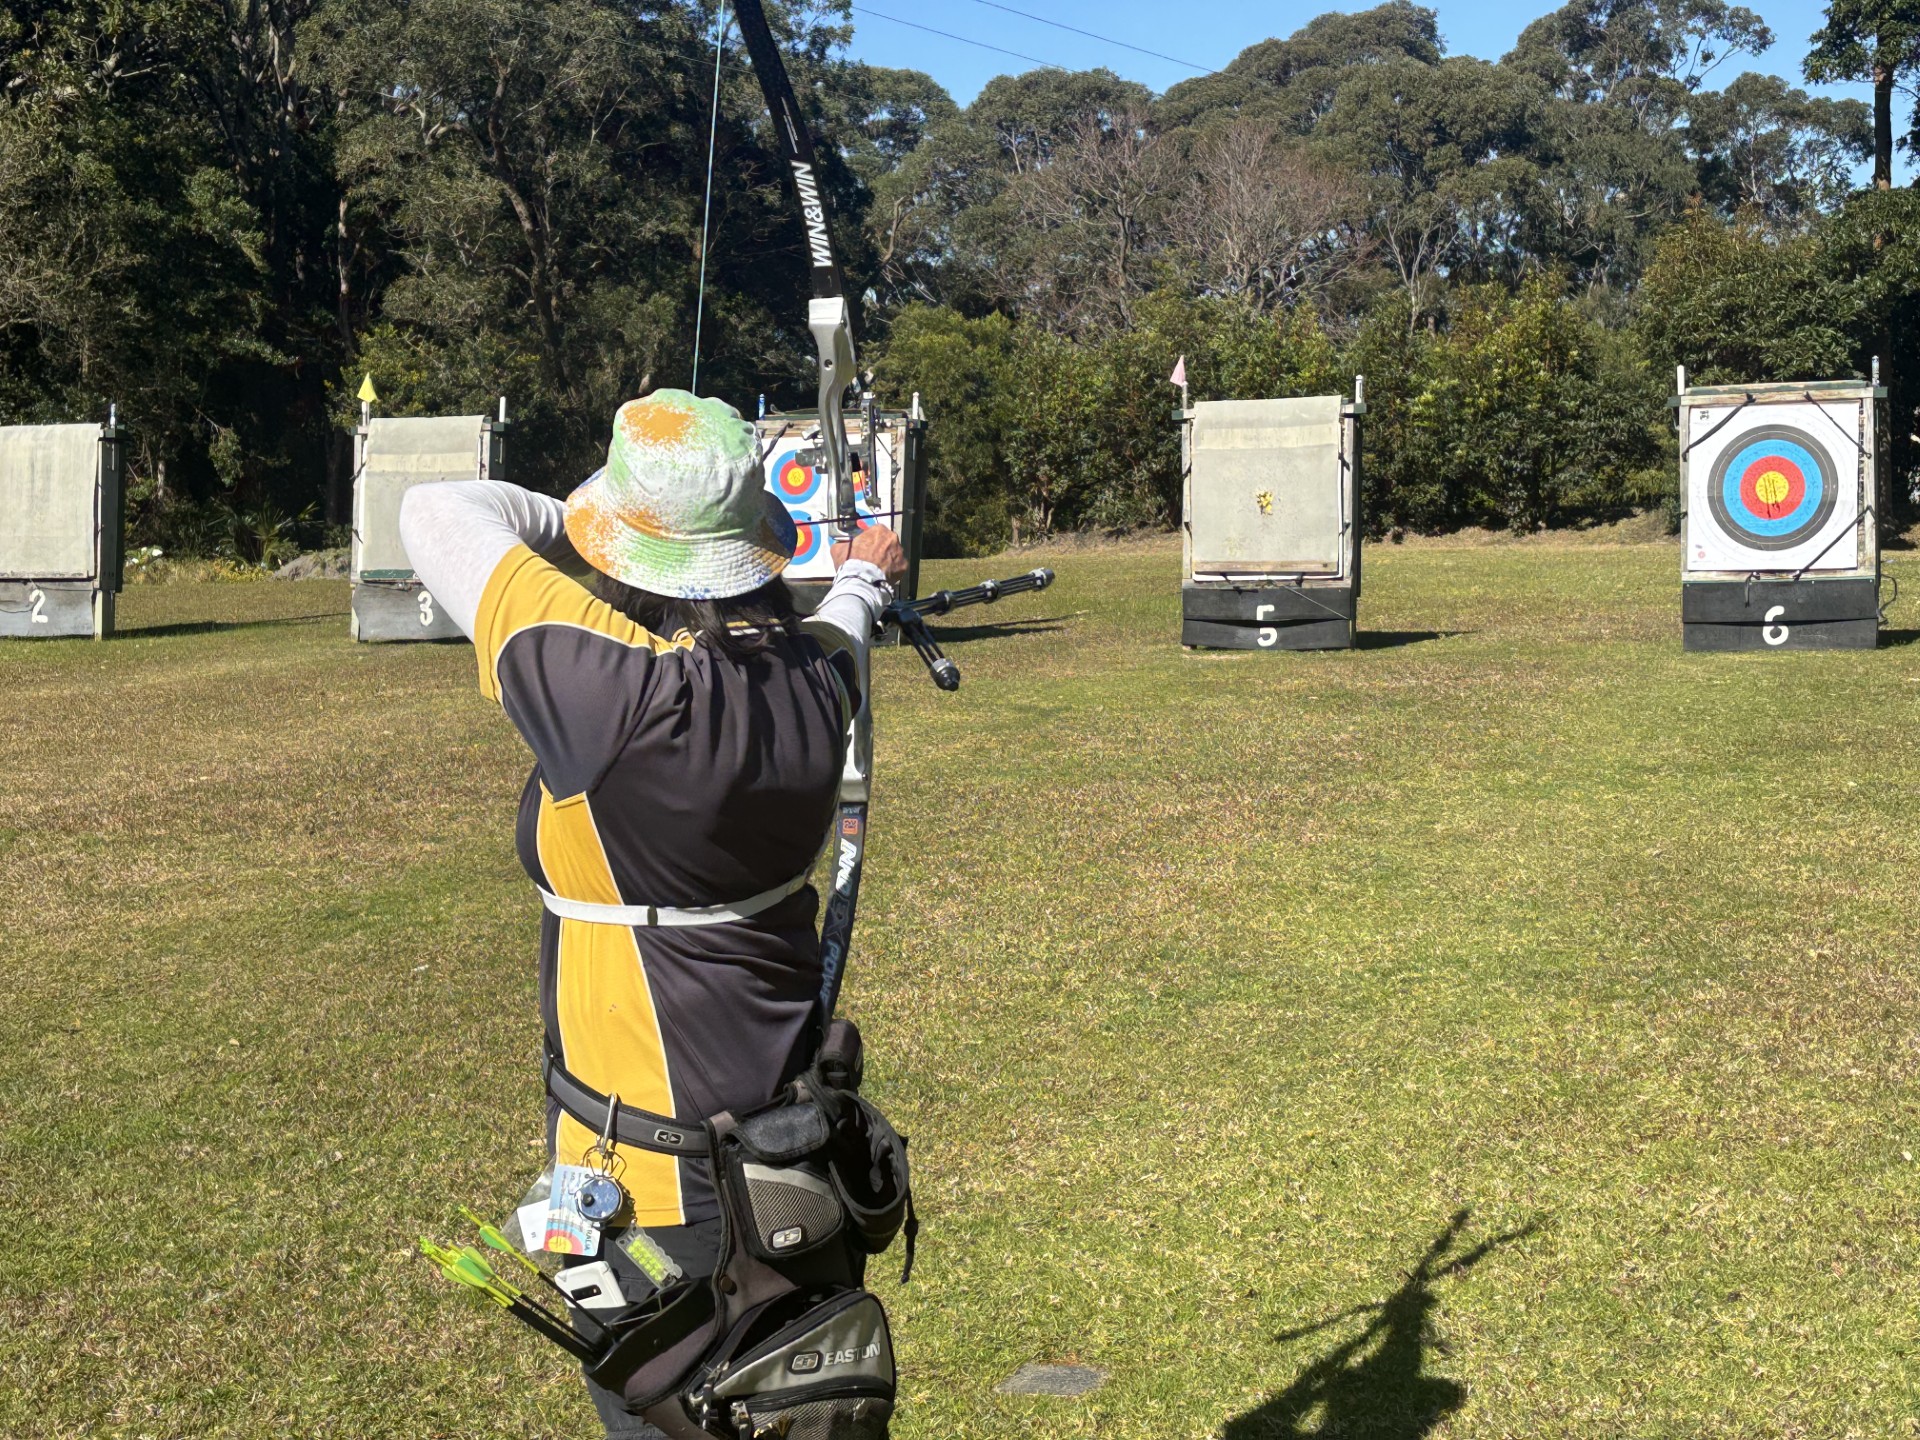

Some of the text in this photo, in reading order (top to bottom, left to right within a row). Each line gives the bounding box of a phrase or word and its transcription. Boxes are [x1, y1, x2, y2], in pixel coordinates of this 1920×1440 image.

[790, 160, 833, 268] WIN&WIN
[29, 589, 48, 624] 2
[417, 590, 434, 627] 3
[1256, 604, 1278, 647] 5
[1762, 604, 1789, 646] 6
[824, 1343, 881, 1366] EASTON
